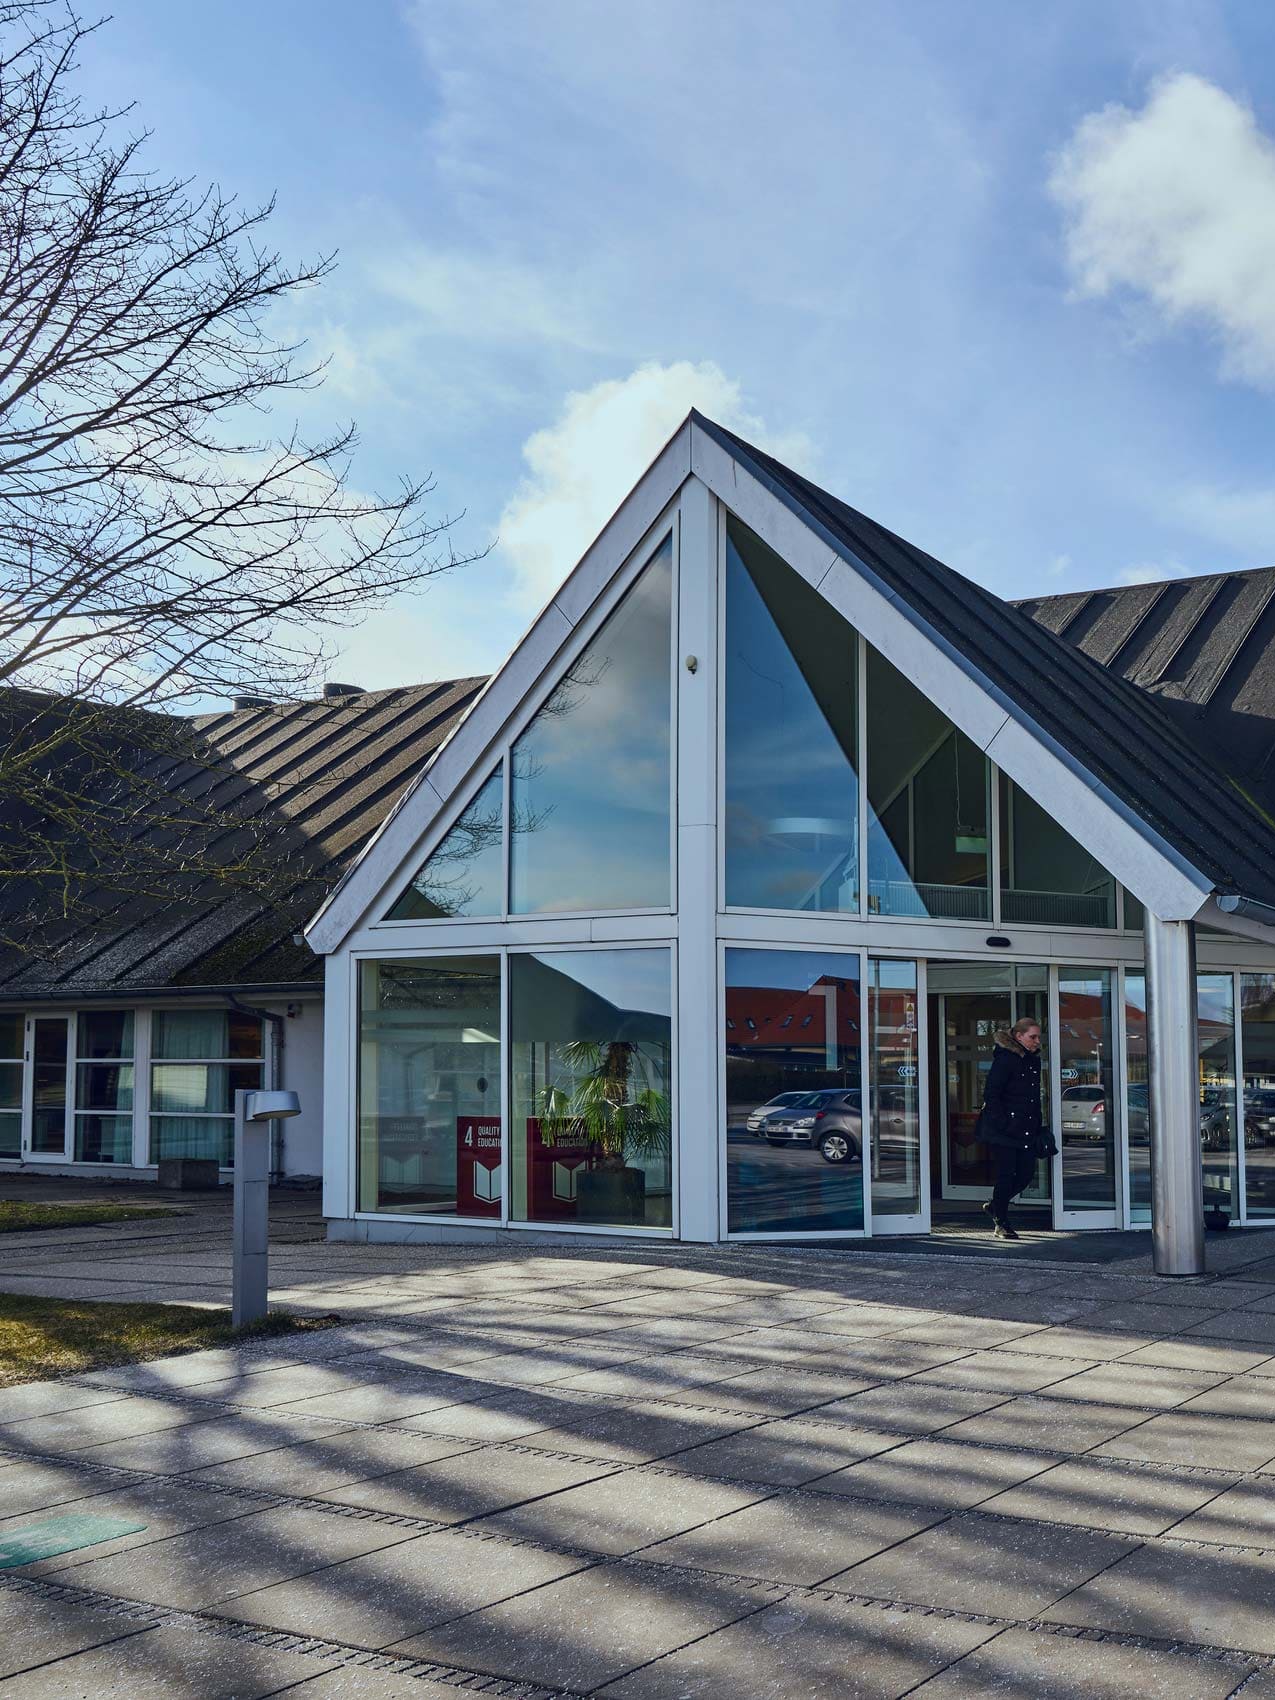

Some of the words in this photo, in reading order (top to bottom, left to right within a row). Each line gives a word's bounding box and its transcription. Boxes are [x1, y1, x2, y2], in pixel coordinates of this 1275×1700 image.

[464, 1125, 473, 1147] 4
[477, 1125, 500, 1136] QUALITY
[477, 1138, 501, 1147] EDUCATI
